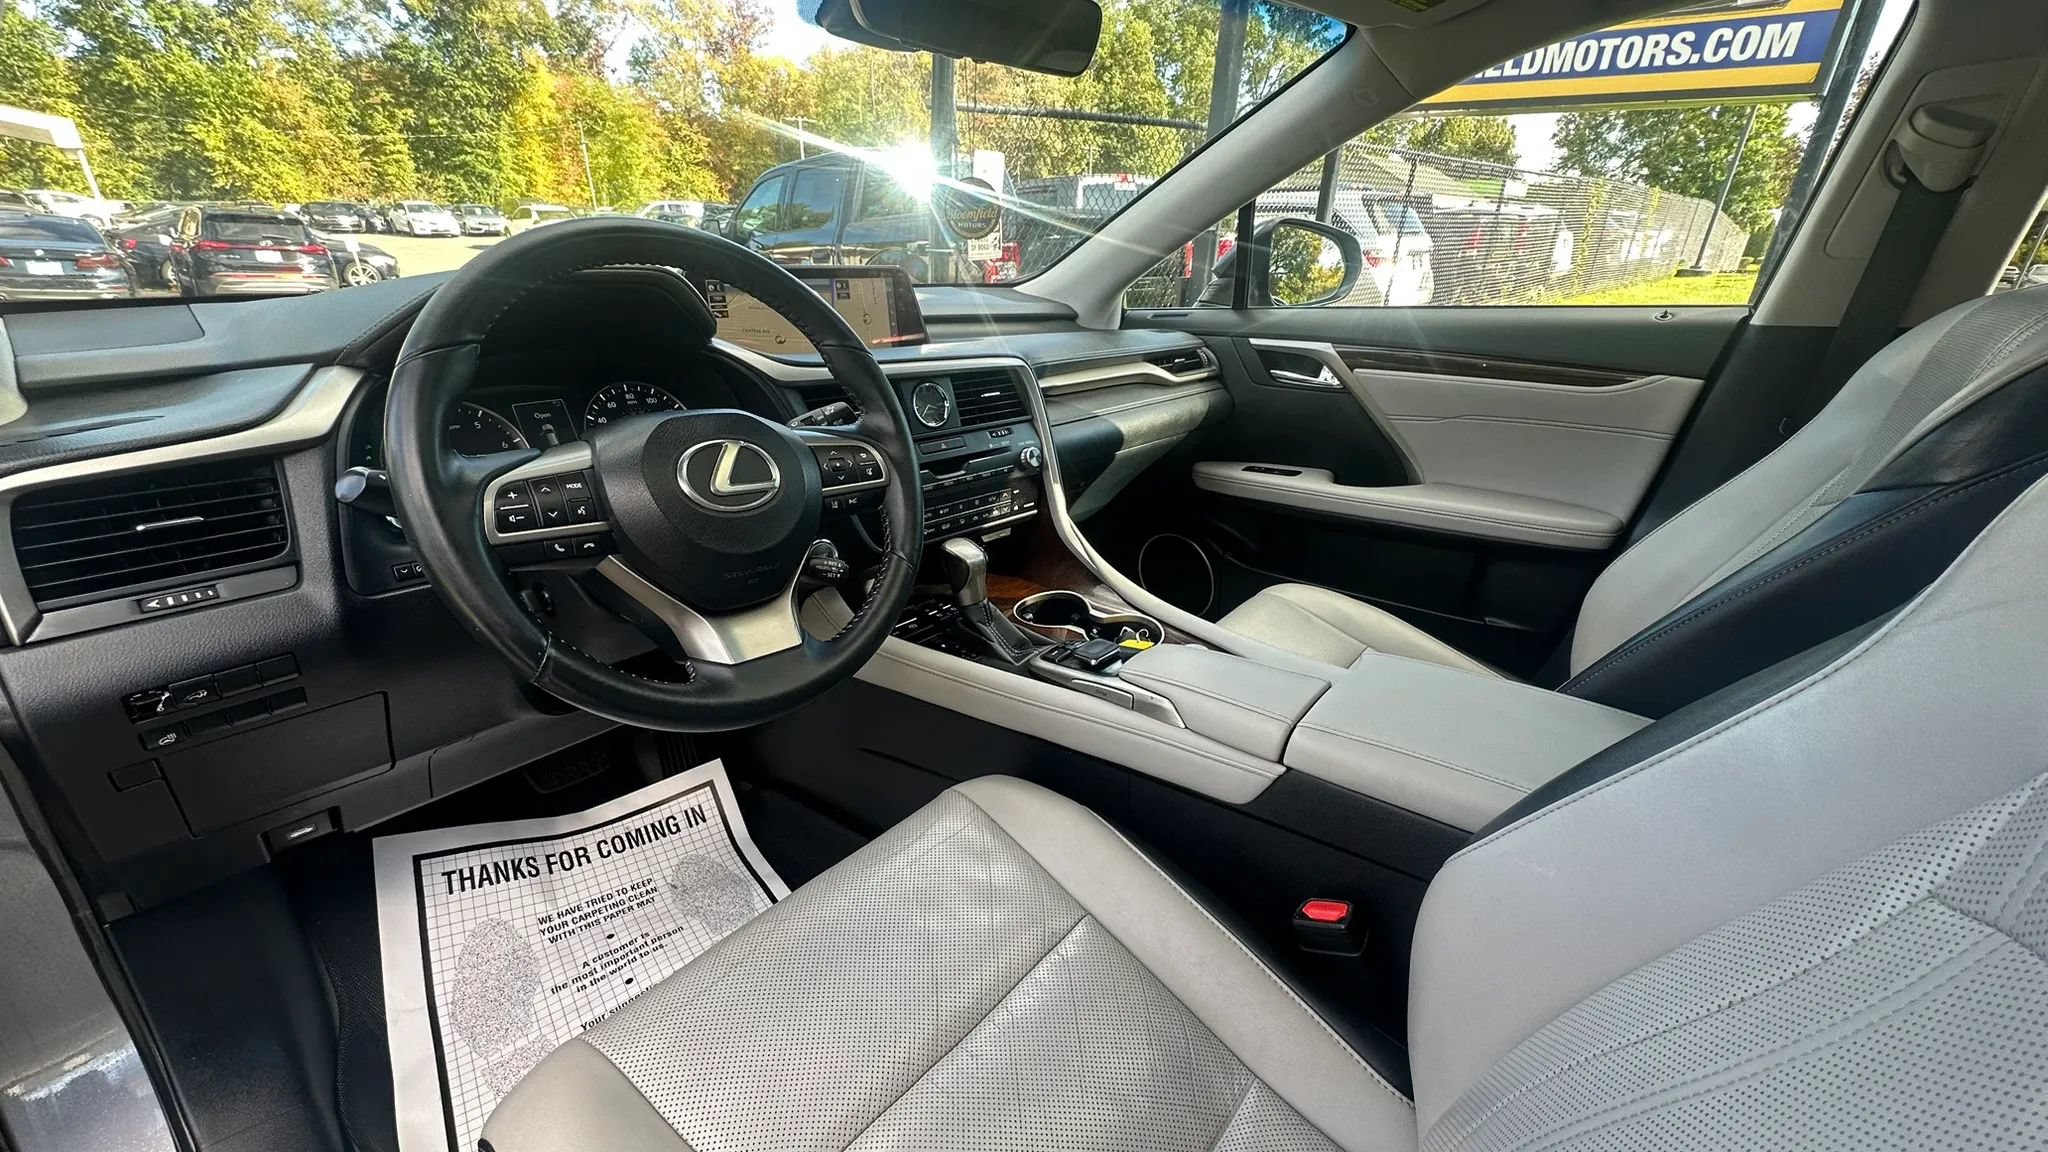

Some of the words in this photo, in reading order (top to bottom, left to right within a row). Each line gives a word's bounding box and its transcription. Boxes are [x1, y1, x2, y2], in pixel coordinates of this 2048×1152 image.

[1475, 21, 1806, 78] LDMOTORS.COM
[957, 221, 987, 229] MOTORS
[534, 411, 552, 420] Open
[607, 401, 617, 409] 60
[474, 421, 482, 430] 5
[502, 441, 509, 449] 6
[565, 482, 583, 490] MODE
[441, 855, 541, 896] THANKS
[545, 846, 592, 875] FOR
[596, 815, 682, 860] COMING
[683, 804, 707, 829] IN
[538, 914, 555, 926] WE
[556, 903, 584, 920] HAVE
[584, 893, 614, 909] TRIED
[615, 887, 628, 897] TO
[630, 877, 653, 892] KEEP
[539, 920, 570, 937] YOUR
[571, 899, 627, 926] CARPETING
[627, 886, 658, 903] CLEAN
[548, 928, 576, 944] WITH
[577, 918, 601, 932] THIS
[603, 905, 635, 922] PAPER
[636, 896, 657, 909] MAT
[550, 981, 569, 995] the
[571, 967, 598, 985] most
[600, 940, 650, 971] important
[650, 925, 684, 946] person
[576, 983, 588, 993] in
[589, 973, 607, 987] the
[608, 957, 638, 976] world
[639, 950, 651, 959] to
[652, 943, 668, 953] us.
[582, 960, 591, 969] A
[592, 936, 639, 964] customer
[640, 931, 651, 939] is
[580, 1012, 606, 1031] Your
